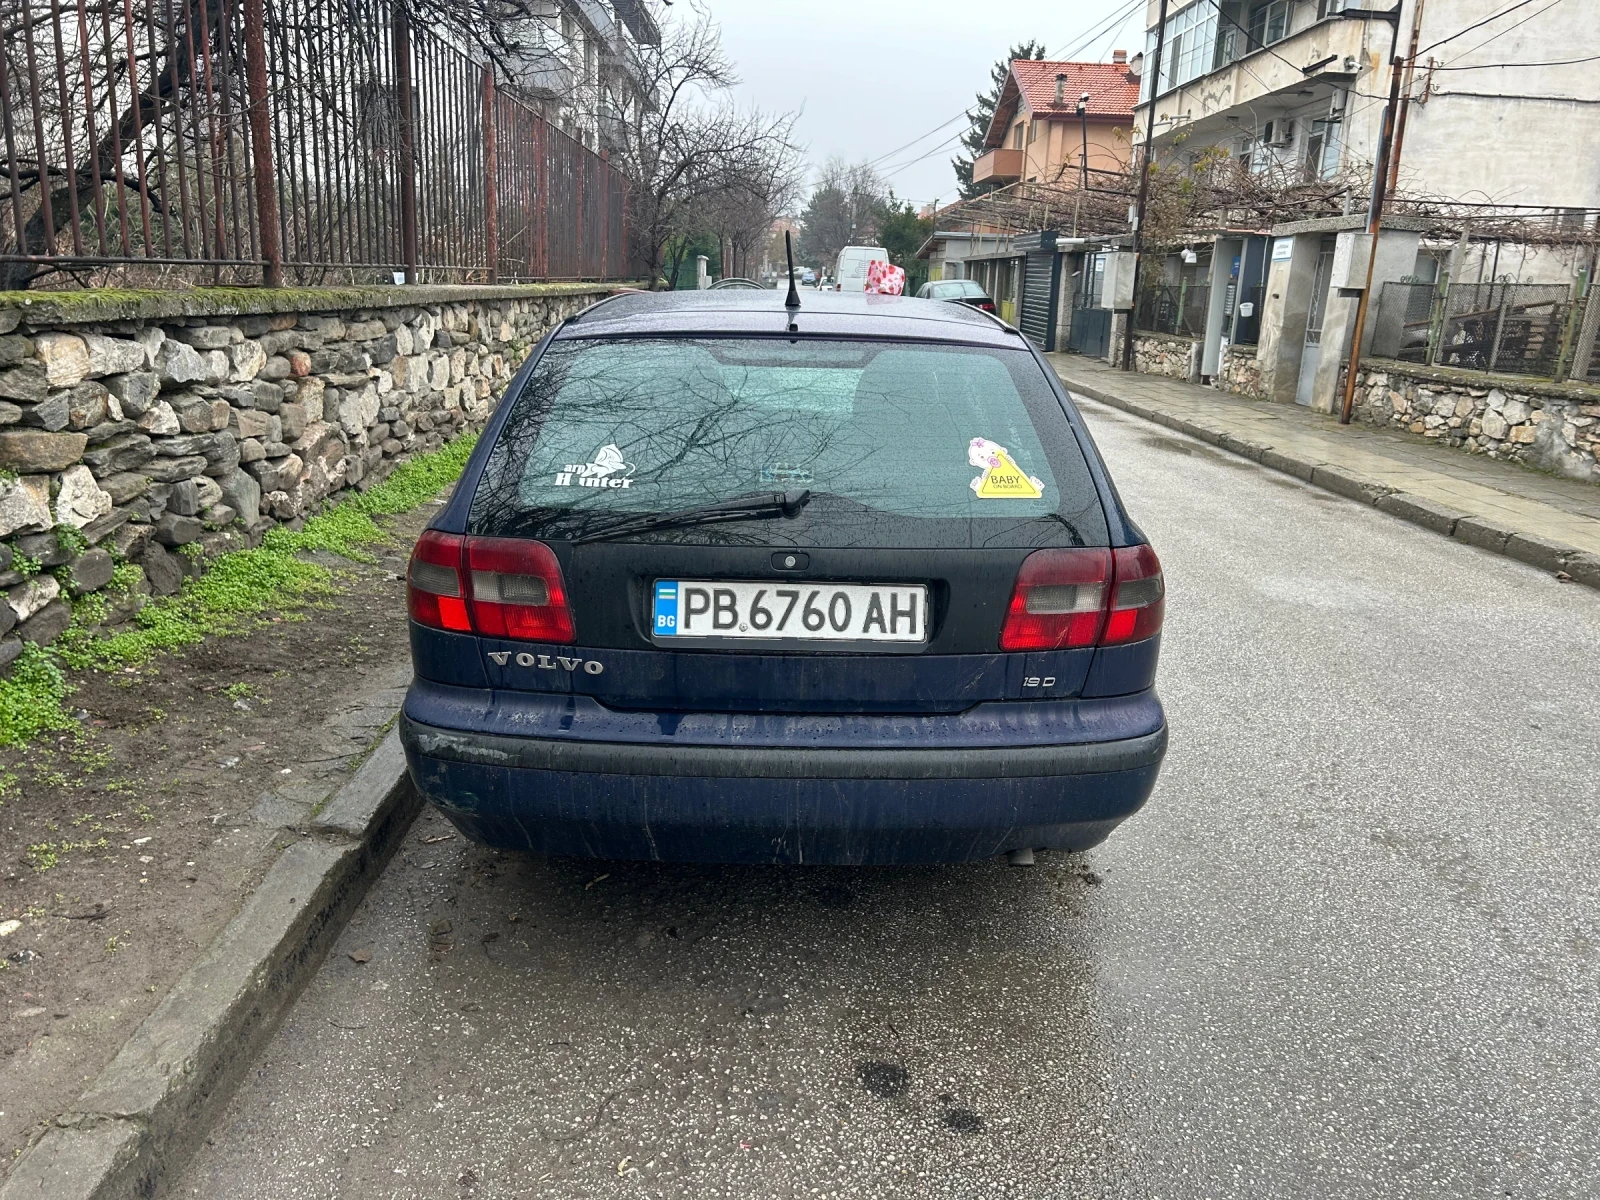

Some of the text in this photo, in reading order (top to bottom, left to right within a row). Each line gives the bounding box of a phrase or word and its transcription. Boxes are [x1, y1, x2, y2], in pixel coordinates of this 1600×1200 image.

[990, 475, 1020, 484] BABY
[750, 590, 852, 632] 6760
[862, 592, 917, 634] AH
[657, 615, 676, 628] BG
[487, 651, 604, 675] VOLVO
